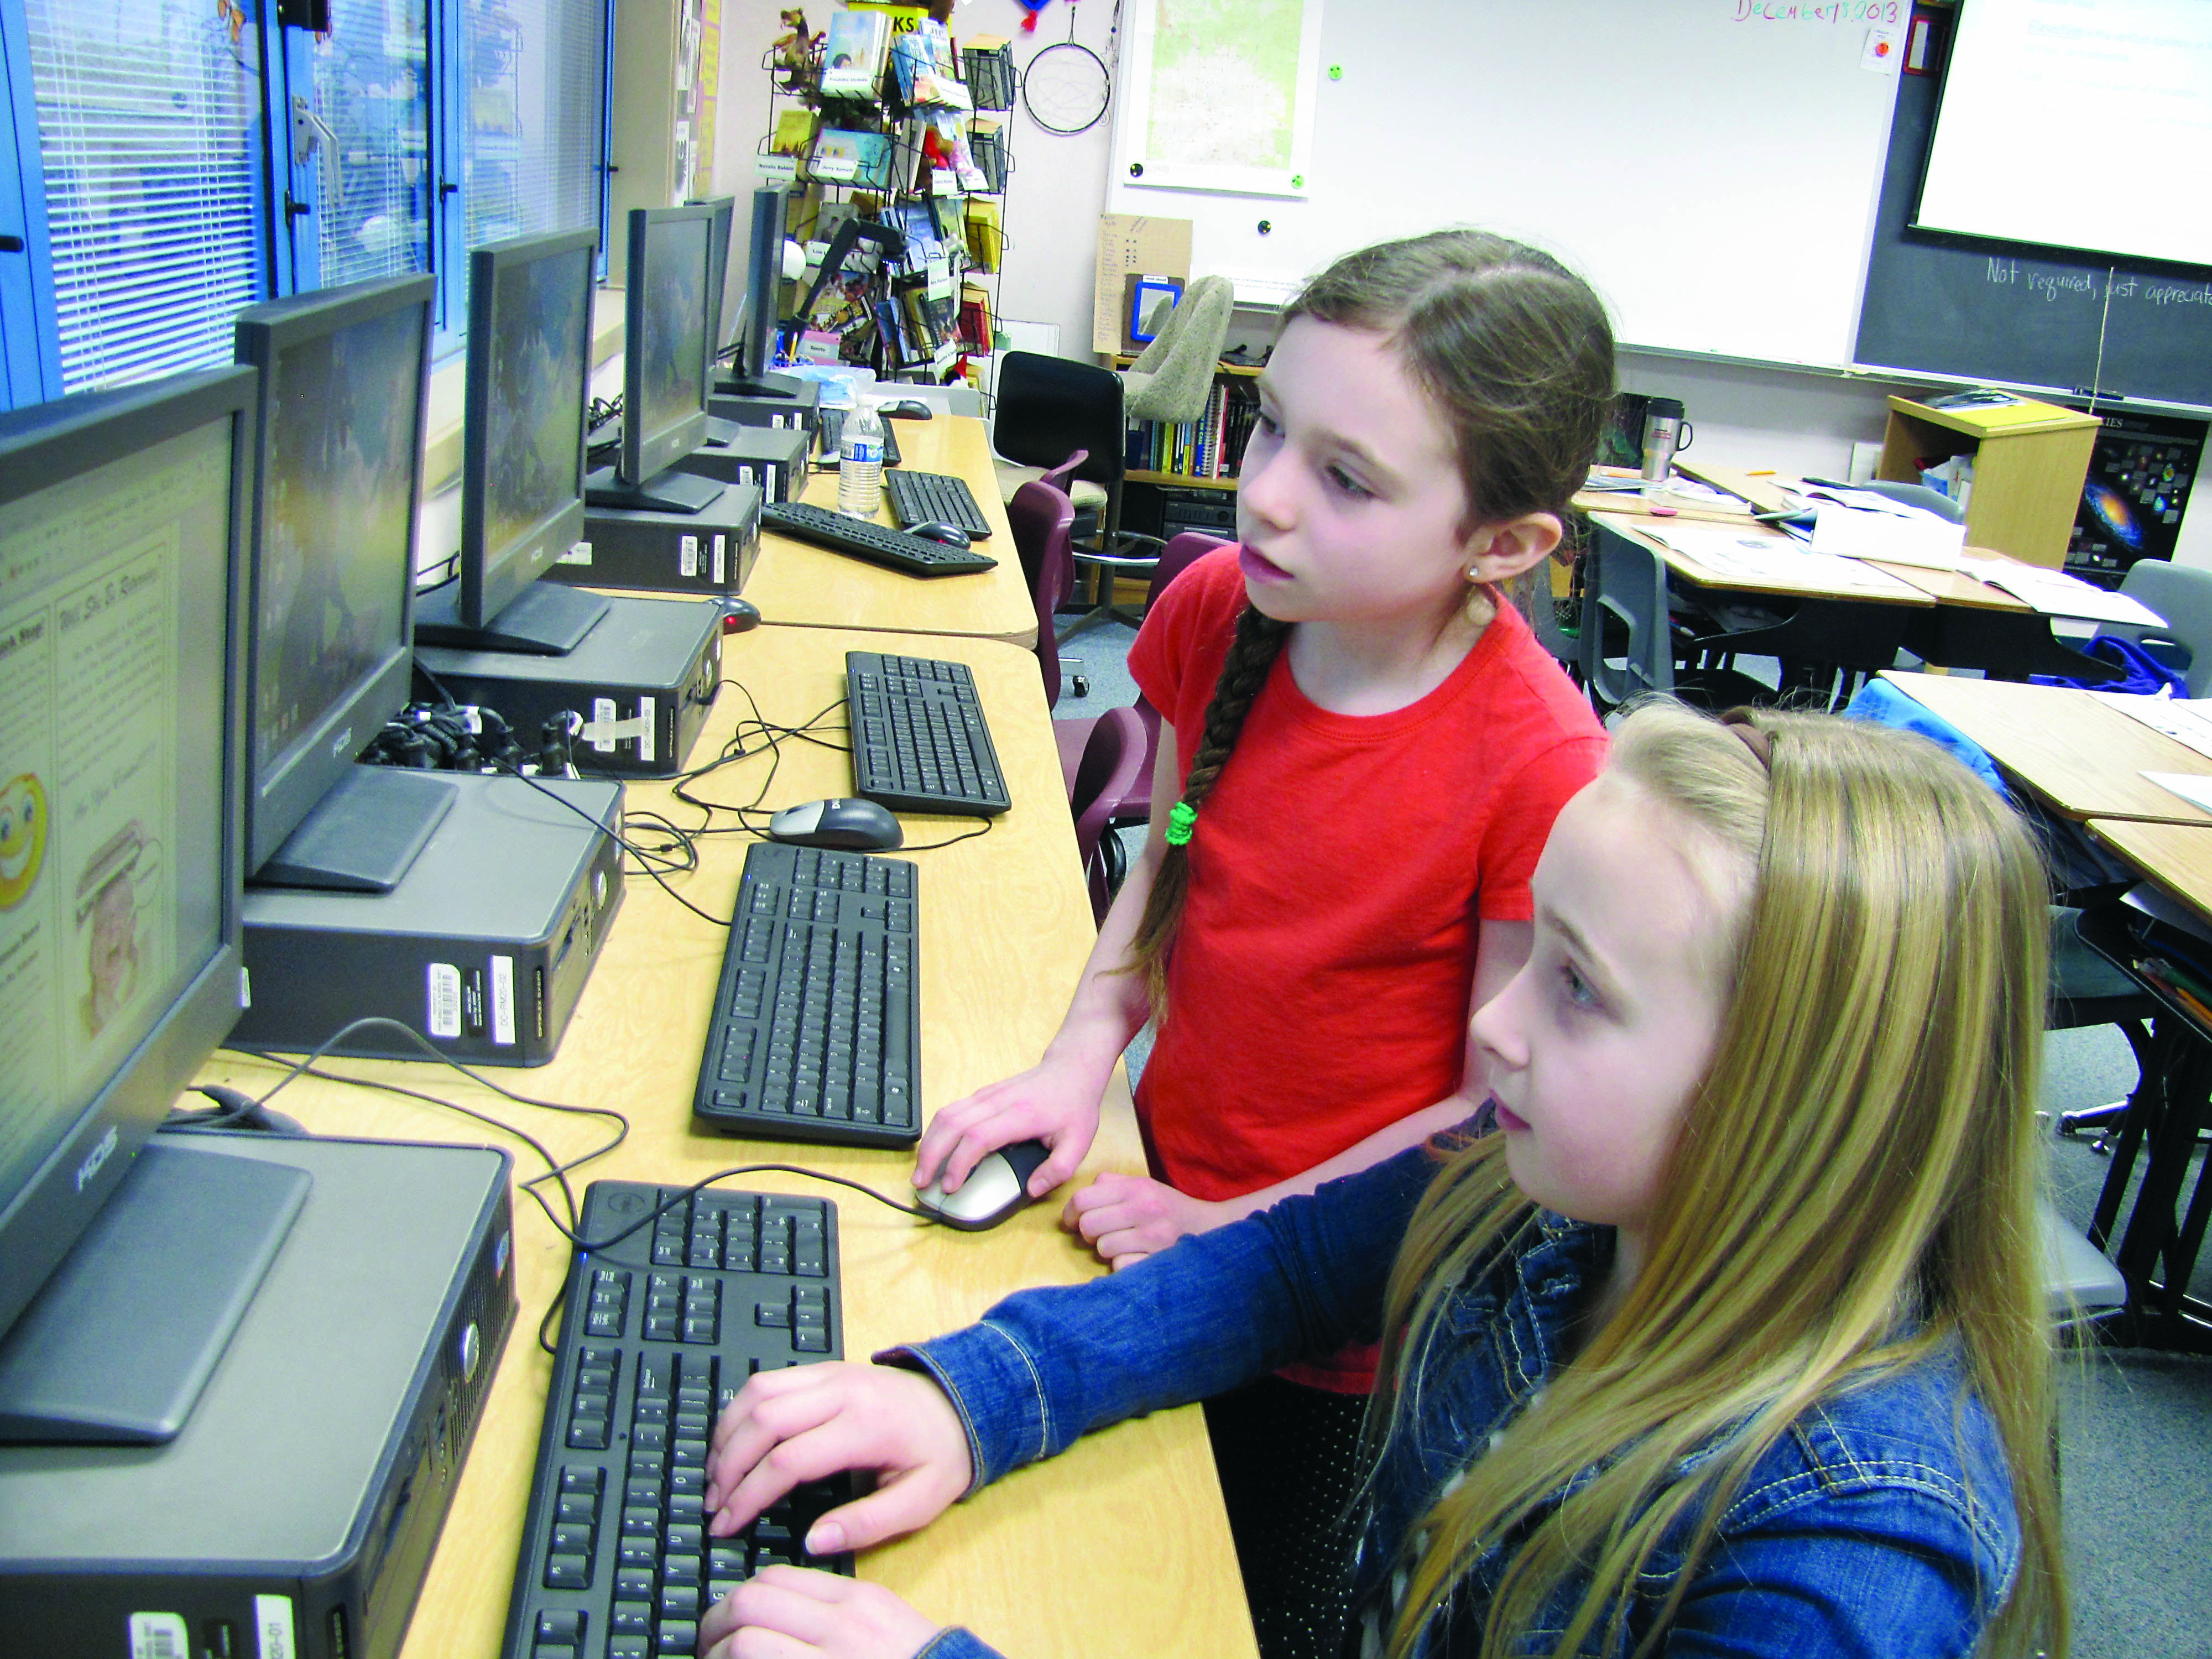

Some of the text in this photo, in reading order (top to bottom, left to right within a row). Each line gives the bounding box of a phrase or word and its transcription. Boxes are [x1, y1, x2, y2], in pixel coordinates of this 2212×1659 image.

[1854, 1, 1897, 23] 2013
[1987, 257, 2019, 284] Not
[2028, 274, 2096, 301] required,
